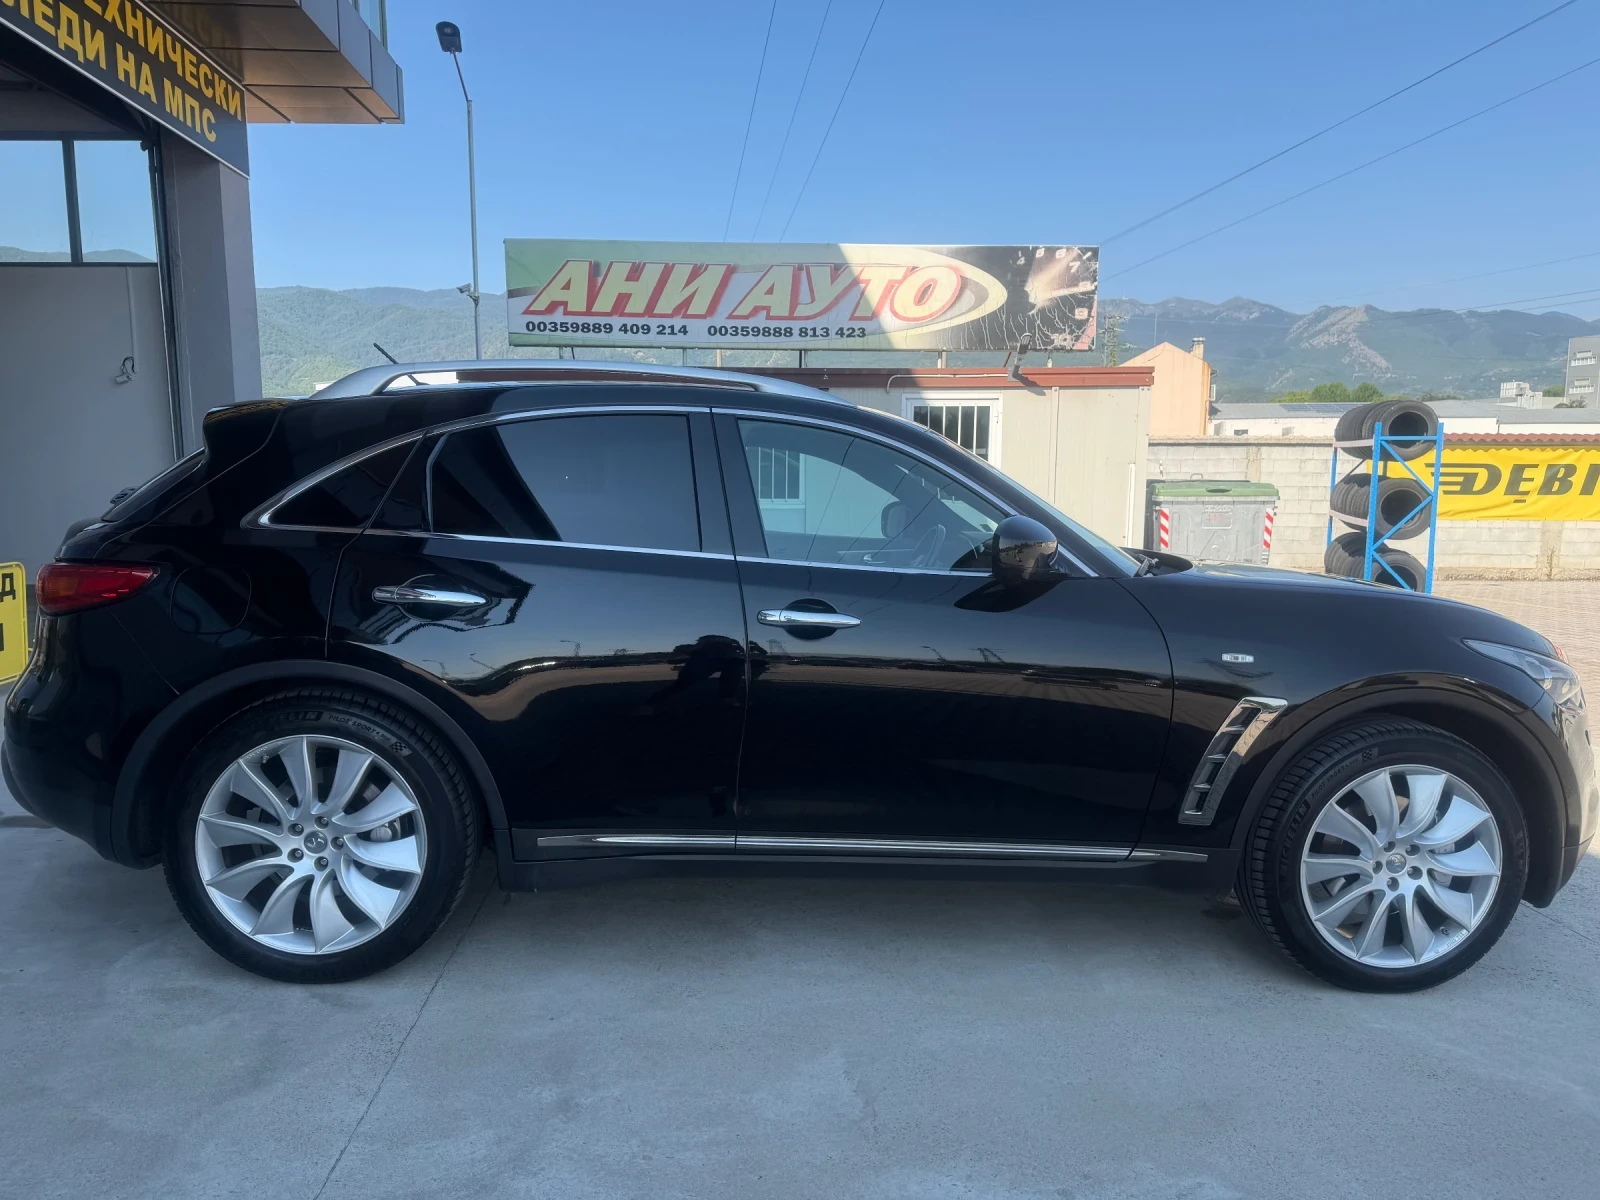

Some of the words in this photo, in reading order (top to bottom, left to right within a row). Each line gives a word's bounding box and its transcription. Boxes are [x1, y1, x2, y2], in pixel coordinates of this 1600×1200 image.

[84, 0, 242, 121] ХНИЧЕСКИ
[116, 42, 157, 104] НА
[164, 77, 216, 142] МПС
[522, 259, 736, 319] АНИ
[726, 263, 962, 322] АУТО
[525, 321, 613, 334] 00359889
[618, 323, 651, 335] 409
[656, 324, 688, 335] 214
[707, 325, 793, 338] 00359888
[798, 326, 830, 338] 813
[835, 326, 866, 338] 423
[328, 714, 350, 724] PILOT
[352, 720, 376, 734] SPORT
